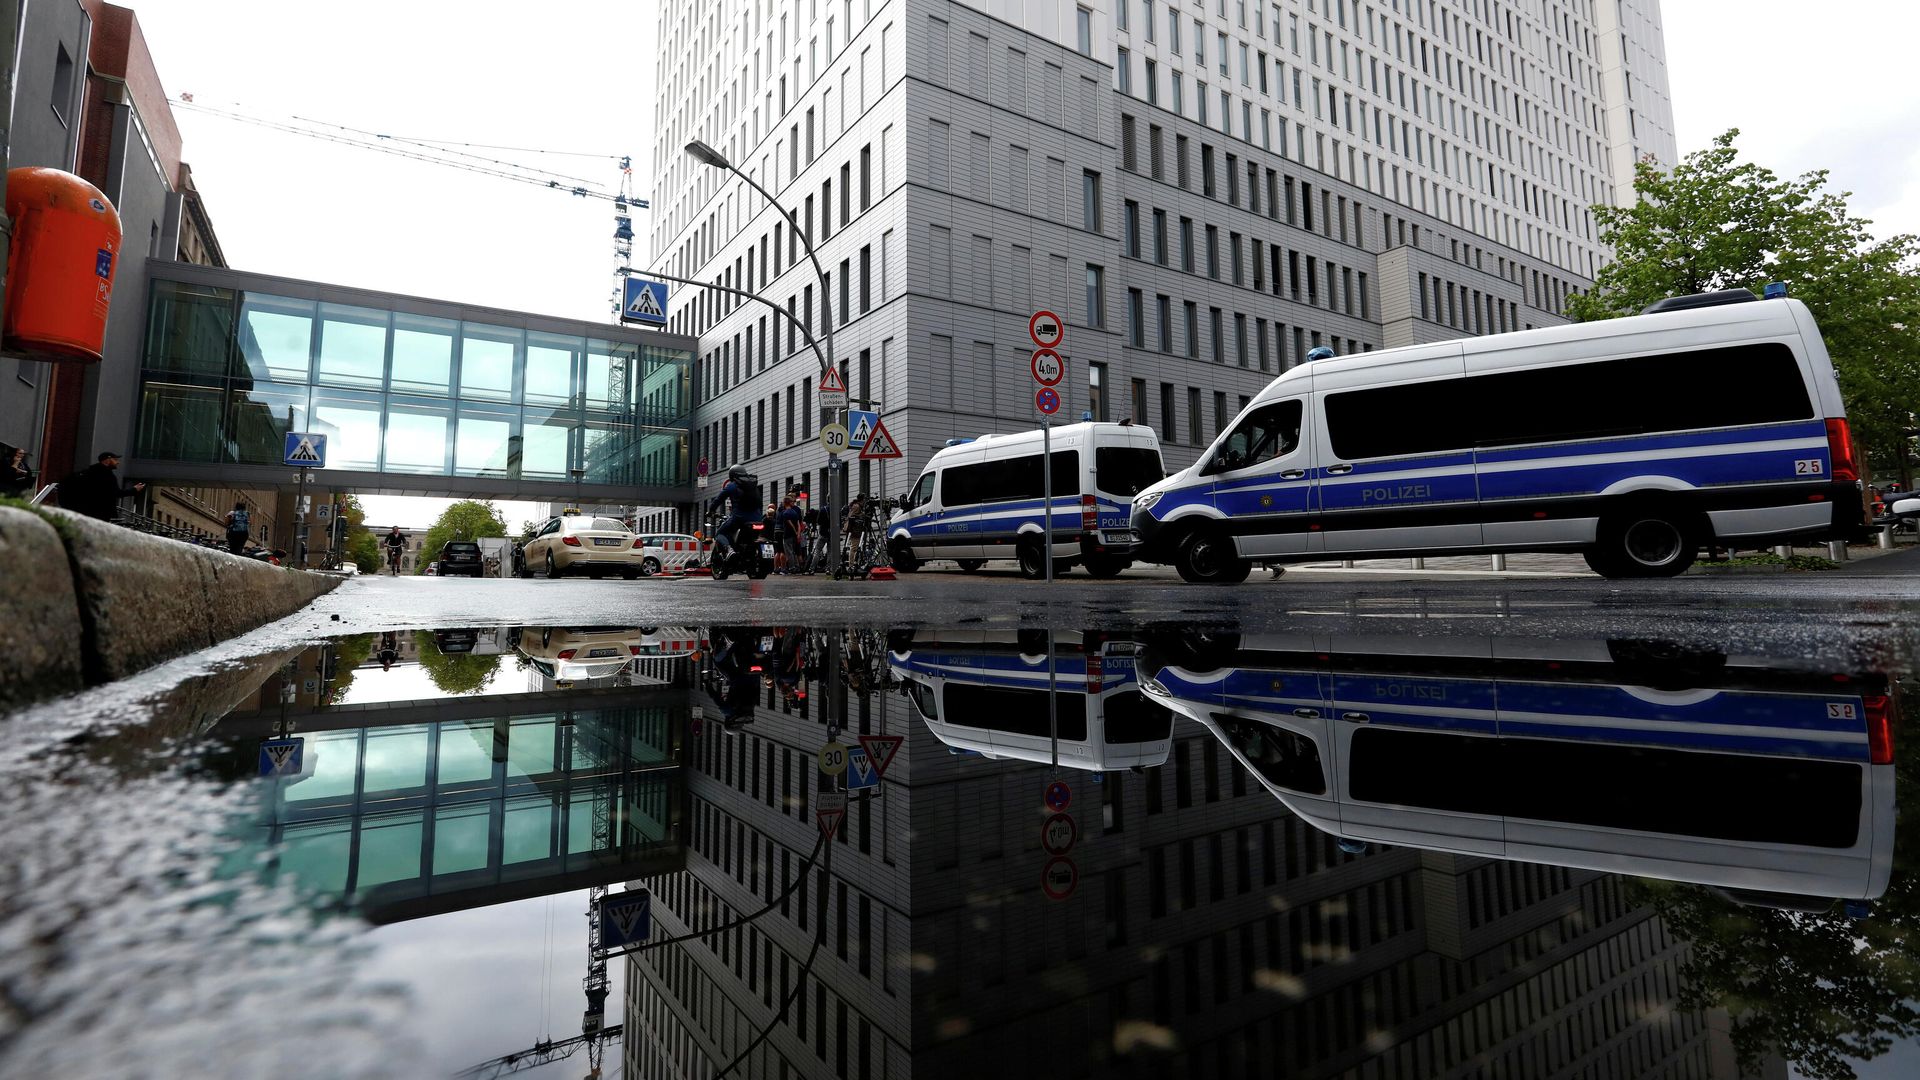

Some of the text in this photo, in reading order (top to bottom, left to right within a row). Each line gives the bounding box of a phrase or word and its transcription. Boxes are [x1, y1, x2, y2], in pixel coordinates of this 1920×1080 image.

[826, 432, 843, 446] 30
[1797, 460, 1820, 474] 25
[1362, 485, 1431, 502] POLIZEI
[948, 523, 969, 531] POLIZEI
[1102, 518, 1130, 527] POLIZE
